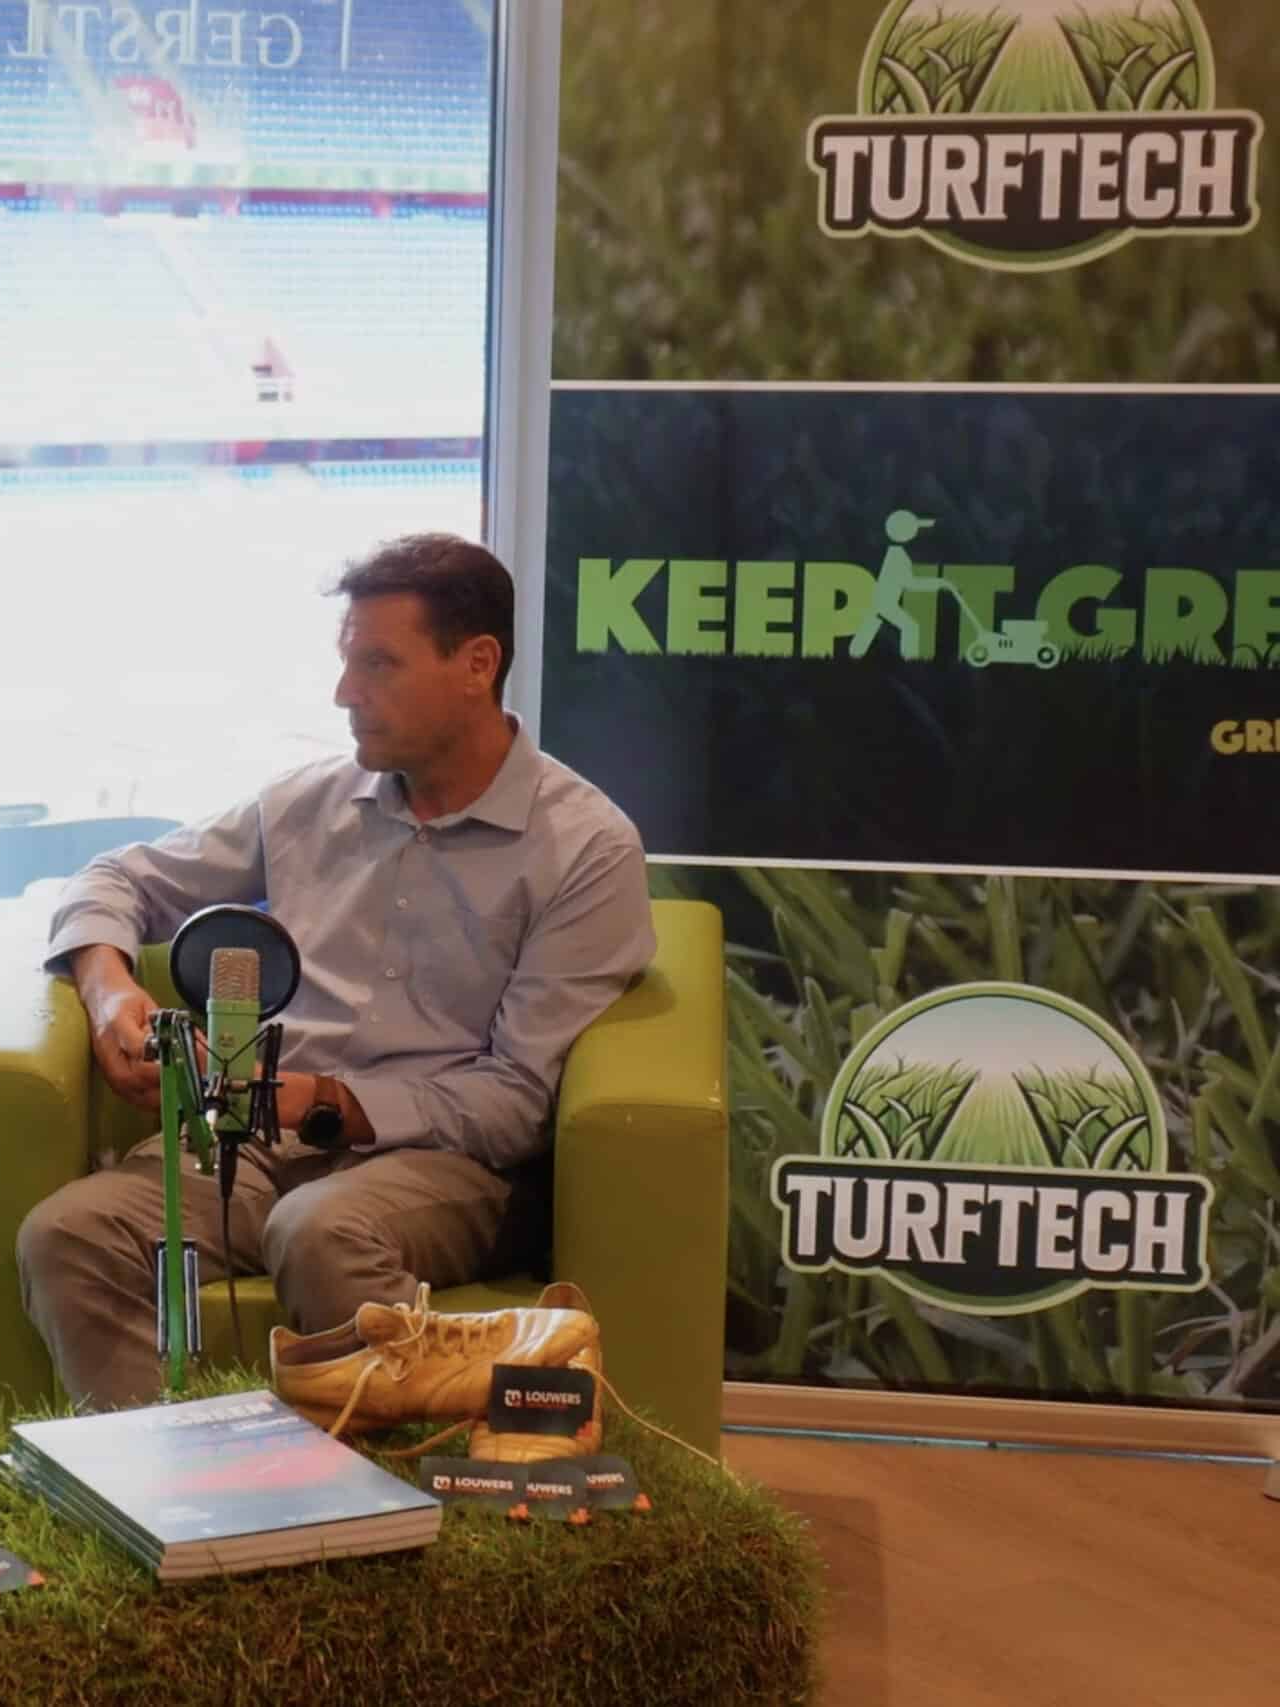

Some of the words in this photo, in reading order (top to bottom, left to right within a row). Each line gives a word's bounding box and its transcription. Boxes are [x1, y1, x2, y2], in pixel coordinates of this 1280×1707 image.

[822, 129, 1239, 222] TURFTECH
[577, 557, 882, 660] KEEP
[1210, 719, 1280, 755] GR
[786, 1174, 1191, 1275] TURFTECH
[525, 1390, 581, 1406] LOUWERS
[455, 1476, 513, 1491] LOUWERS
